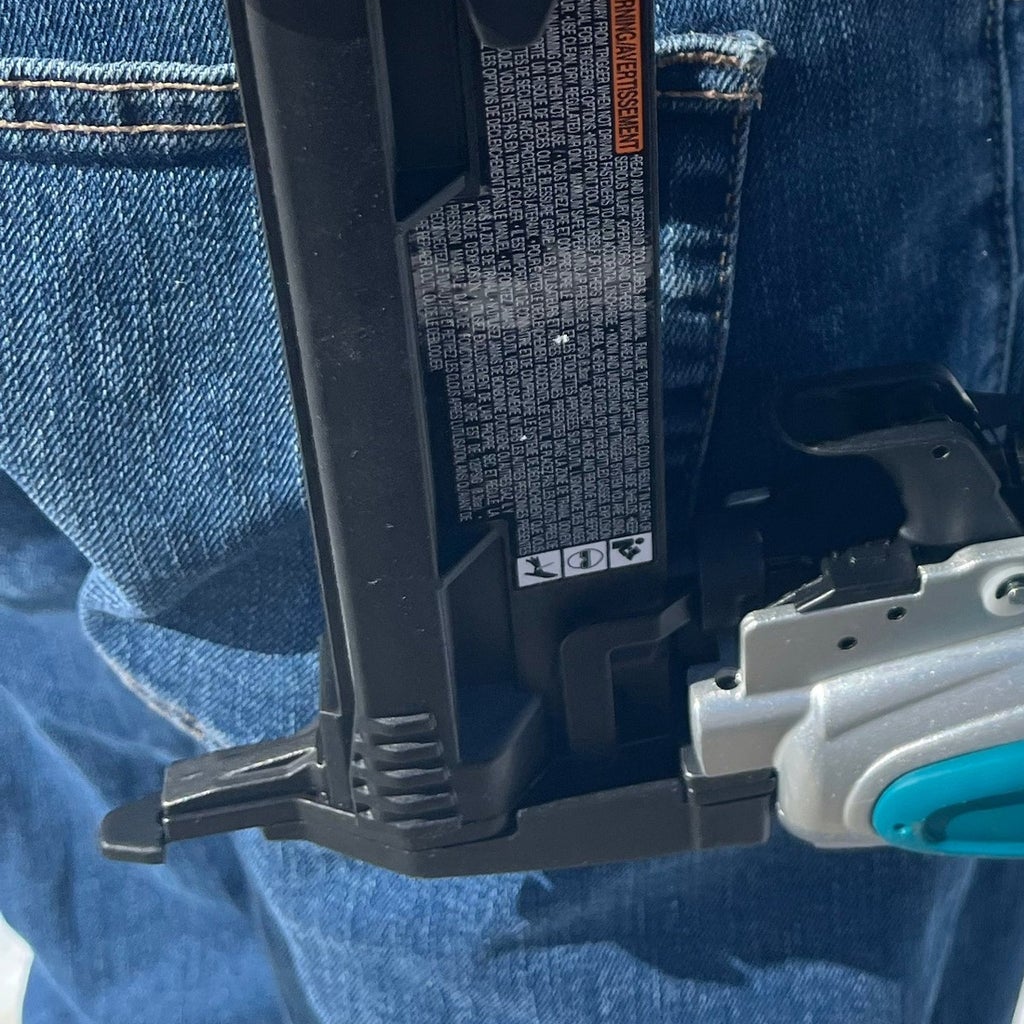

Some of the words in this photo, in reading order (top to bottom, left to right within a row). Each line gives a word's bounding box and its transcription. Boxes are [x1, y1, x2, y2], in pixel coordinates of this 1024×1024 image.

[578, 25, 592, 44] FOR
[594, 20, 608, 46] FROM
[595, 46, 609, 84] TRIGGER
[596, 84, 610, 110] WHEN
[597, 110, 611, 128] NOT
[567, 132, 581, 148] AIR
[598, 128, 612, 161] DRIVING
[584, 160, 598, 184] POINT
[614, 155, 628, 190] SERIOUS
[569, 172, 583, 209] MAXIMUM
[585, 184, 598, 207] TOOL
[630, 177, 643, 195] AND
[570, 208, 584, 230] SAFE
[585, 205, 599, 216] AT
[601, 206, 614, 218] TO
[586, 215, 600, 254] YOURSELF
[601, 217, 615, 241] AVOID
[588, 254, 601, 267] OR
[632, 245, 645, 266] TOOL
[573, 271, 586, 284] AIR
[588, 266, 602, 297] OTHERS
[618, 264, 630, 281] AND
[632, 266, 645, 294] LABELS
[574, 283, 588, 324] PRESSURE
[589, 296, 602, 306] IN
[618, 281, 631, 311] OTHERS
[590, 305, 603, 327] WORK
[619, 310, 632, 320] IN
[576, 322, 588, 331] IS
[619, 319, 632, 342] WORK
[620, 340, 633, 360] AREA
